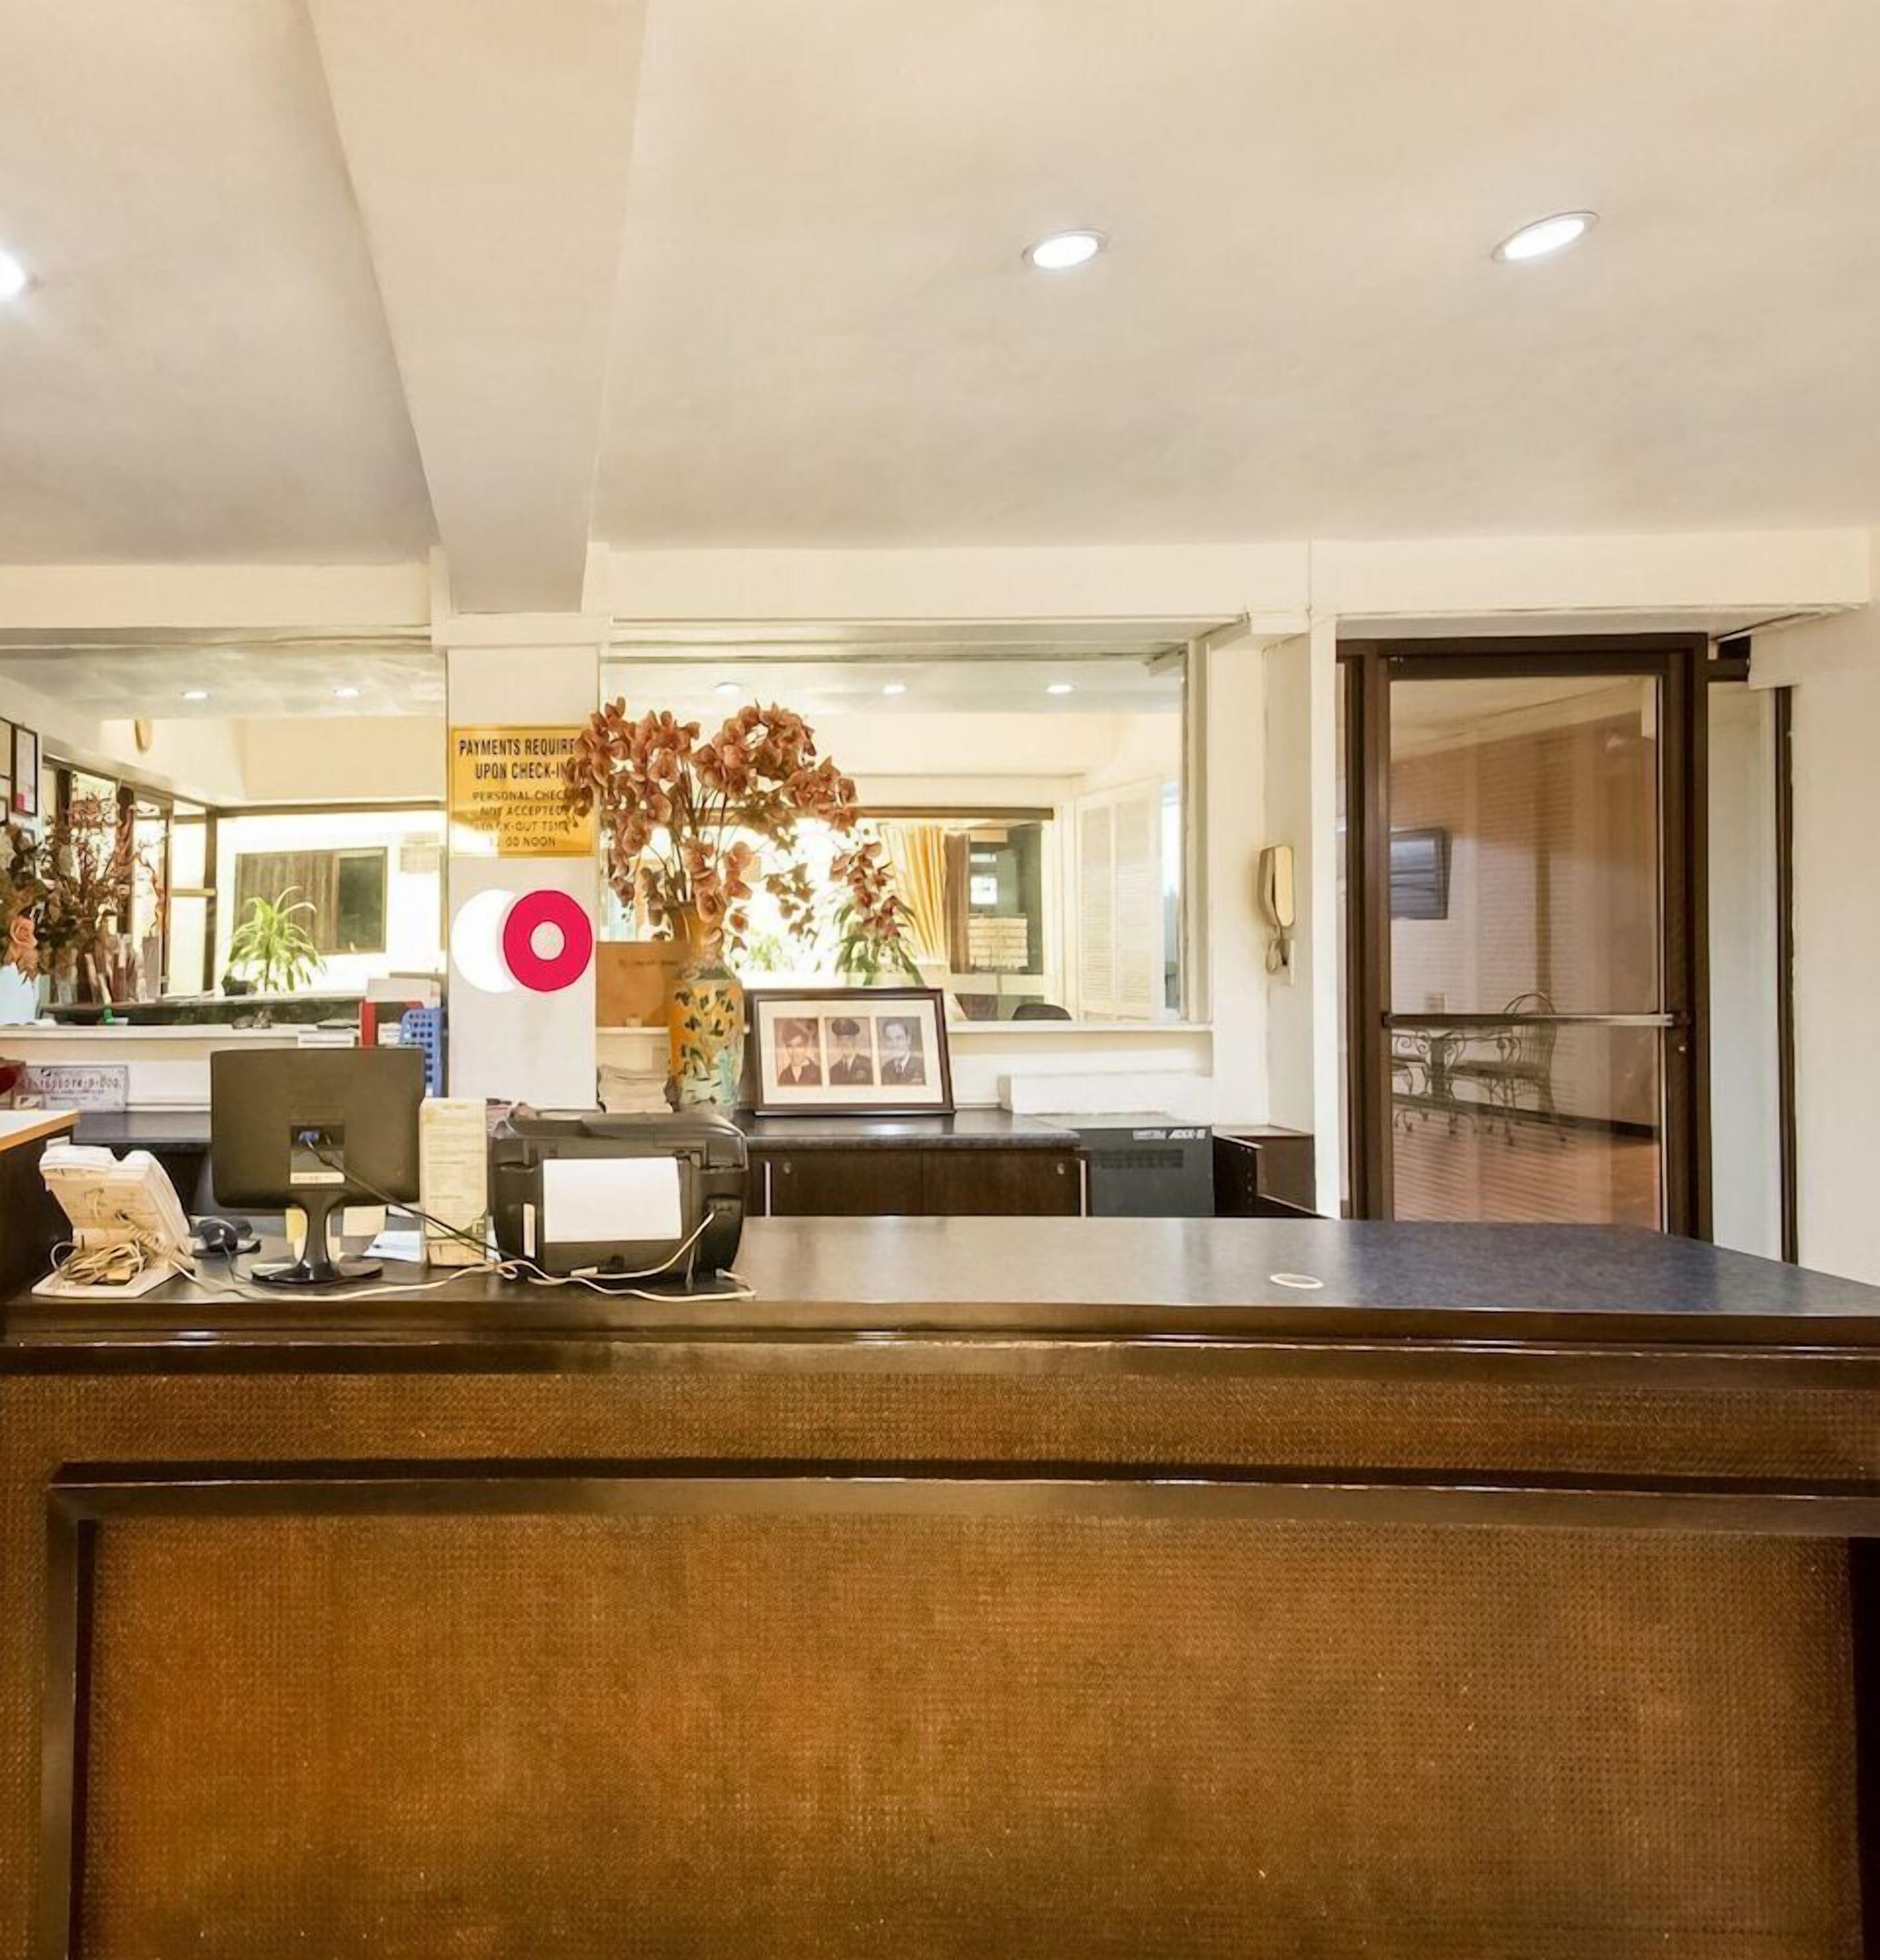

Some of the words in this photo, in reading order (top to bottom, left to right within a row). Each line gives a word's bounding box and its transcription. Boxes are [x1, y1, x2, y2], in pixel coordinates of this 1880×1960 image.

[460, 738, 520, 755] PAYMENTS
[525, 738, 574, 755] REQUIRE
[475, 762, 507, 779] UPON
[473, 790, 530, 801] PERSONAL
[523, 836, 555, 847] NOON
